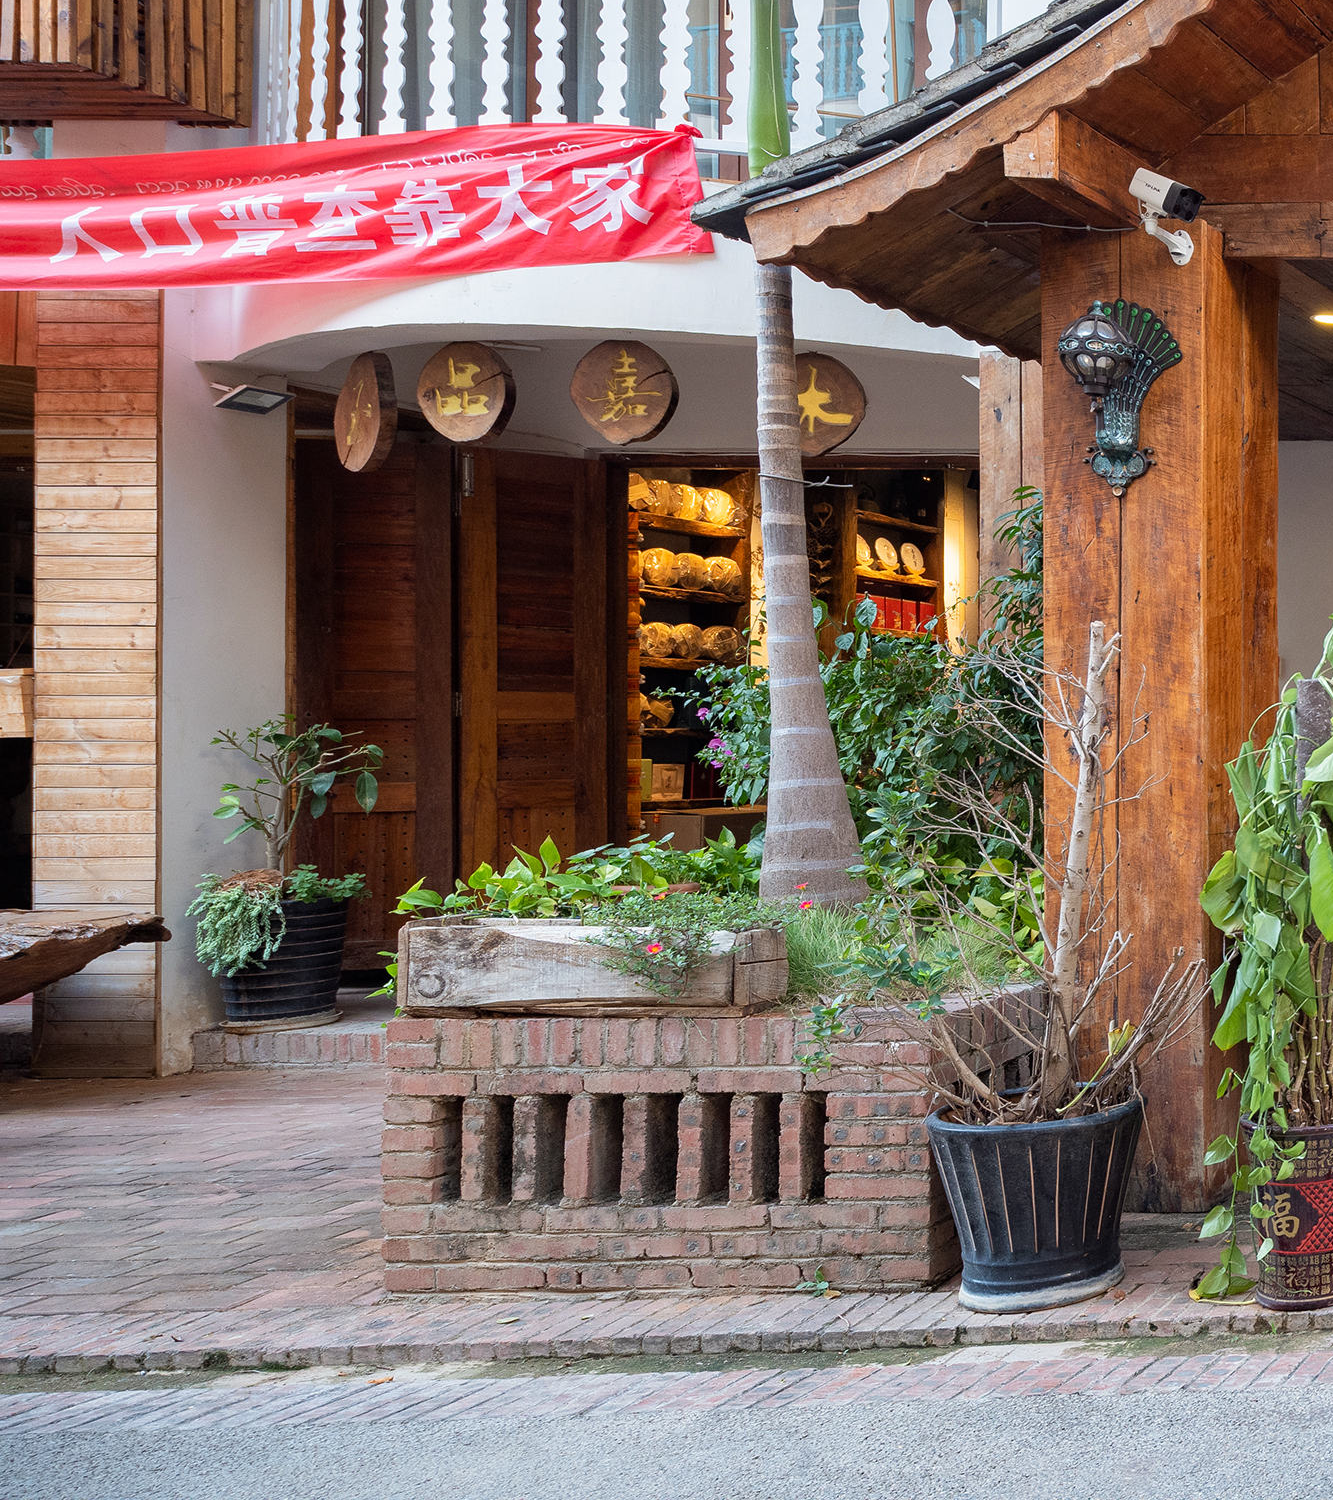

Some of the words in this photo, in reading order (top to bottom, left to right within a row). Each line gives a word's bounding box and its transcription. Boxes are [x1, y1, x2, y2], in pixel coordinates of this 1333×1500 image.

[50, 155, 655, 264] 人口普查靠大家
[435, 356, 490, 418] 品
[586, 348, 663, 423] 嘉
[1262, 1191, 1300, 1239] 福
[1286, 1266, 1311, 1289] 福
